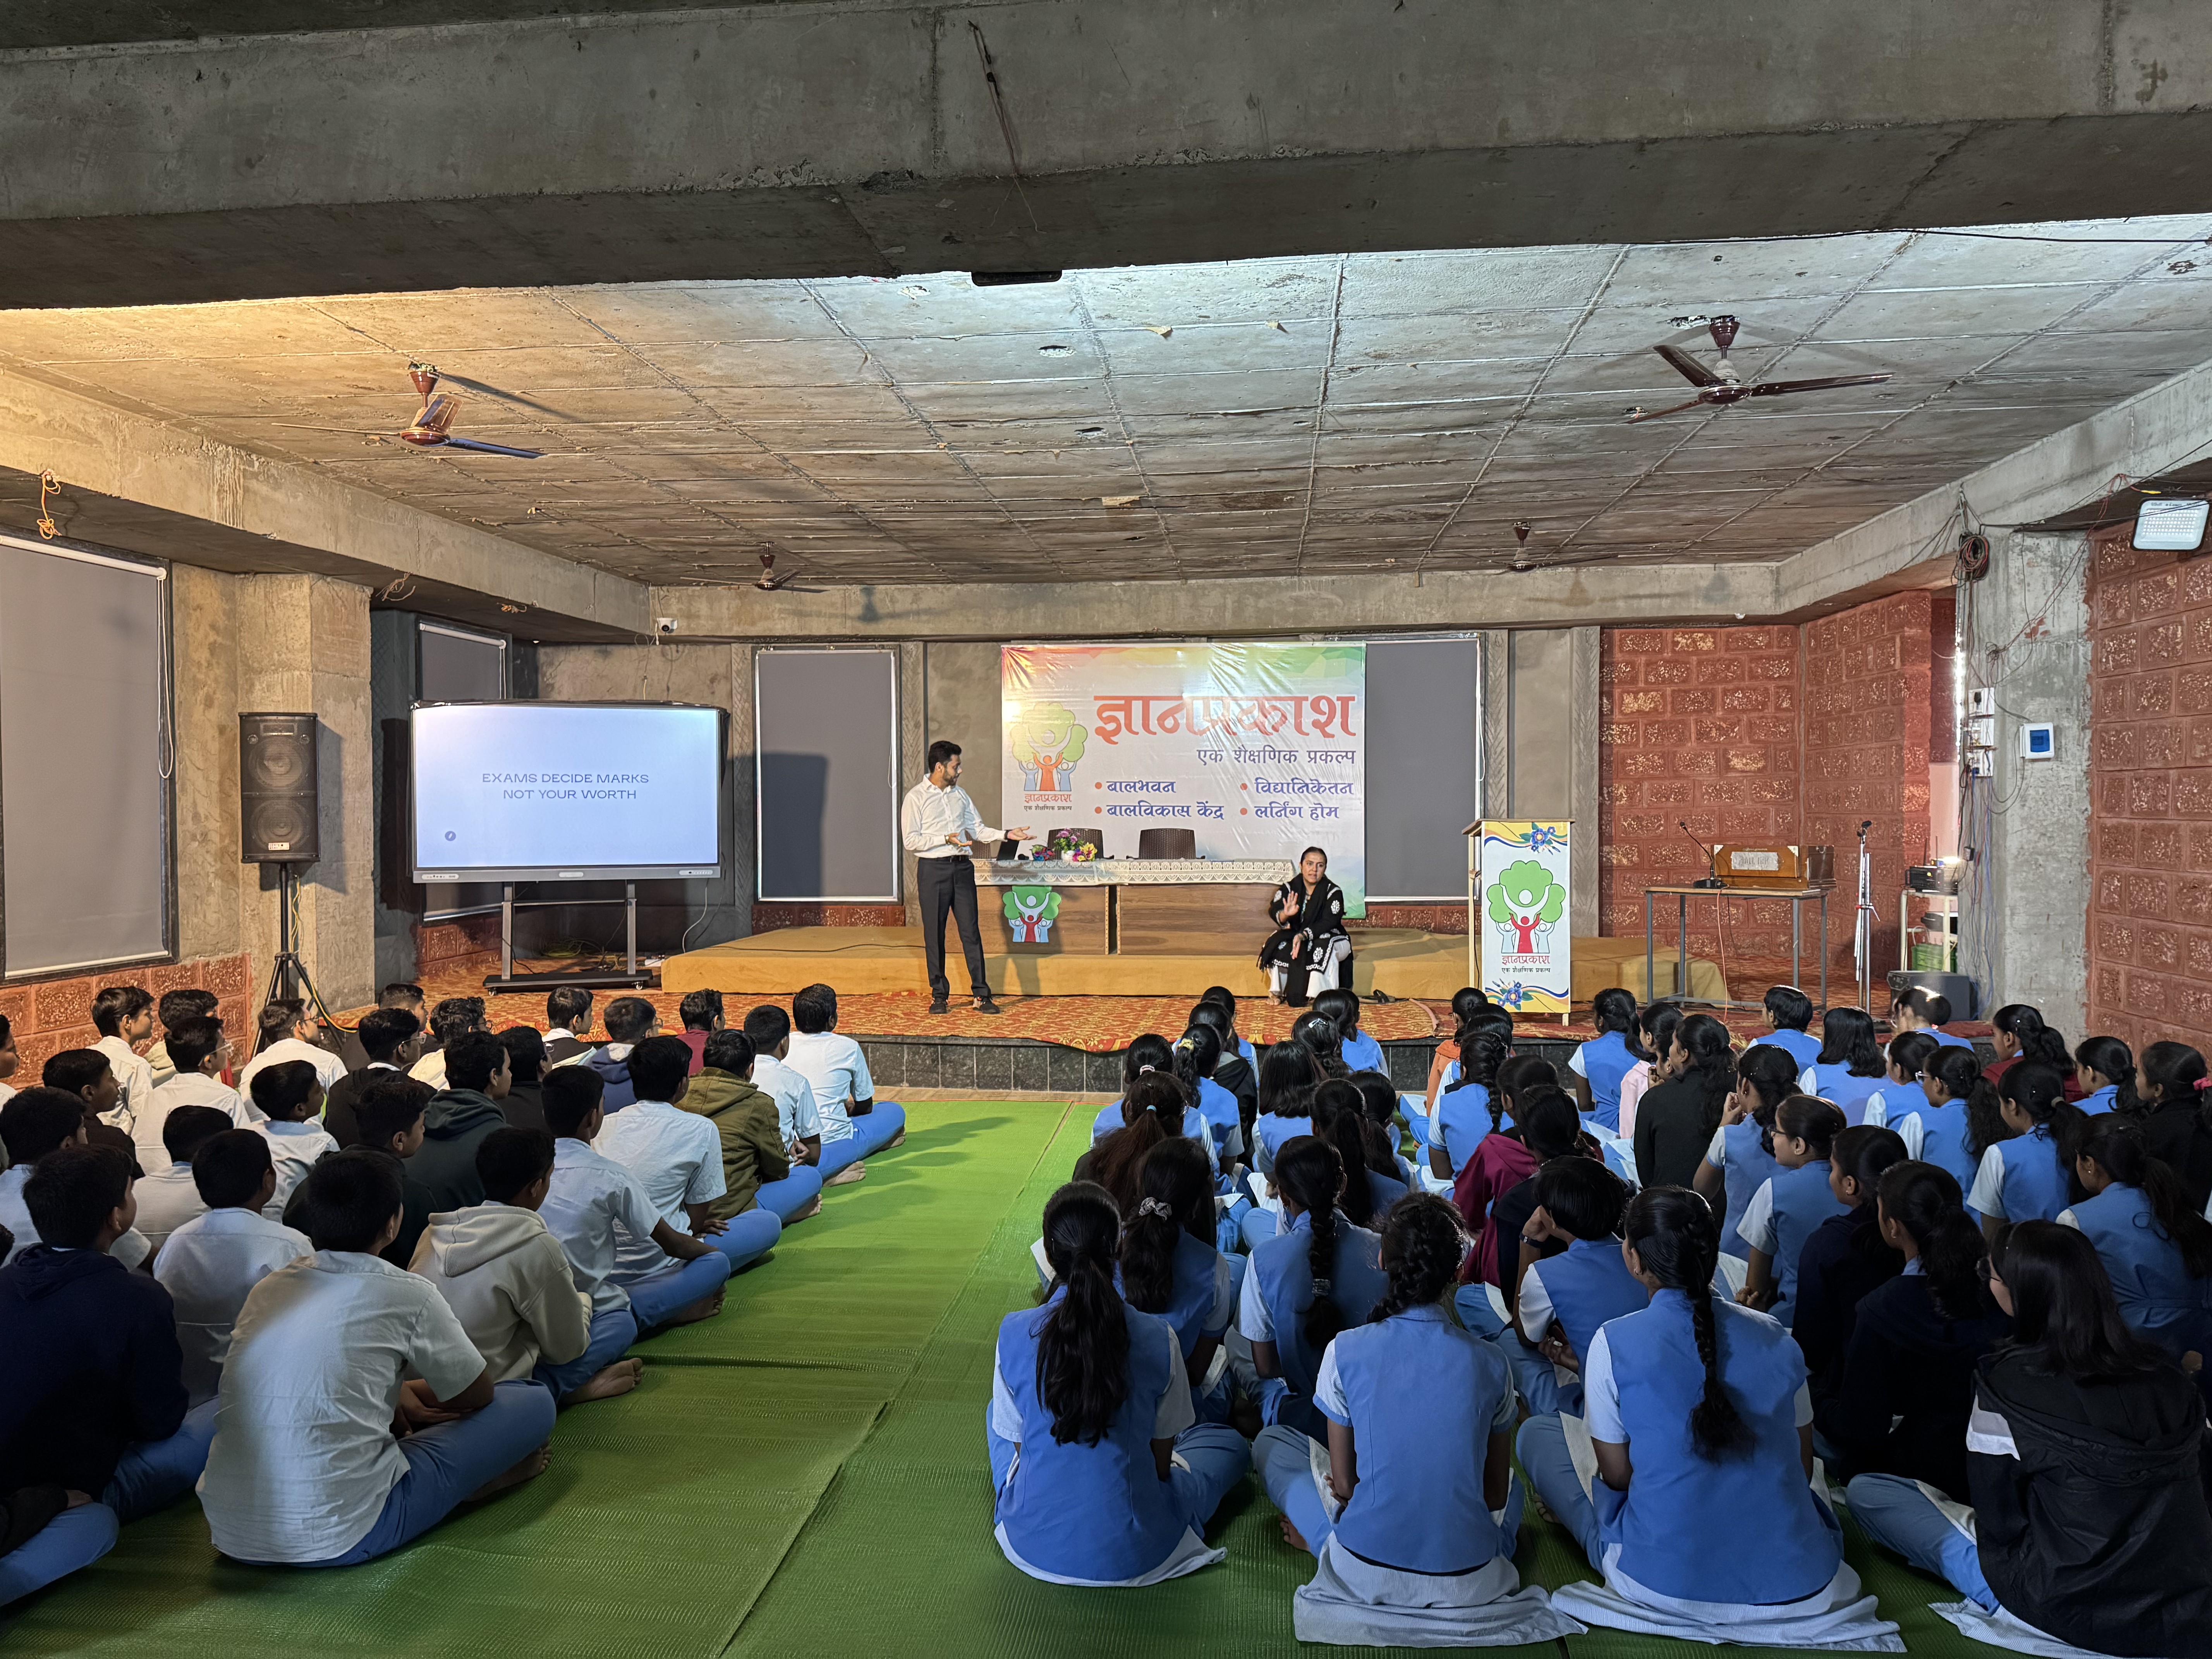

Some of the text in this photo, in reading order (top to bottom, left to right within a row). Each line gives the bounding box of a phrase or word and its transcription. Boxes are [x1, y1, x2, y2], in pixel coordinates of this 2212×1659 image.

[1094, 695, 1356, 745] ज्ञानप्रकाश
[1196, 744, 1356, 765] एक शैक्षणिक प्रकल्प
[482, 773, 649, 783] EXAMS DECIDE MARKS
[1254, 777, 1354, 794] विद्यानिकेतन
[1106, 780, 1176, 793] बालभवन
[503, 790, 636, 799] NOT YOUR WORTH
[1025, 794, 1072, 804] ज्ञानप्रकाश
[1106, 800, 1224, 820] बालविकास केंद्र
[1254, 801, 1340, 821] लर्निंग होम
[1501, 955, 1550, 965] ज्ञानप्रकाश
